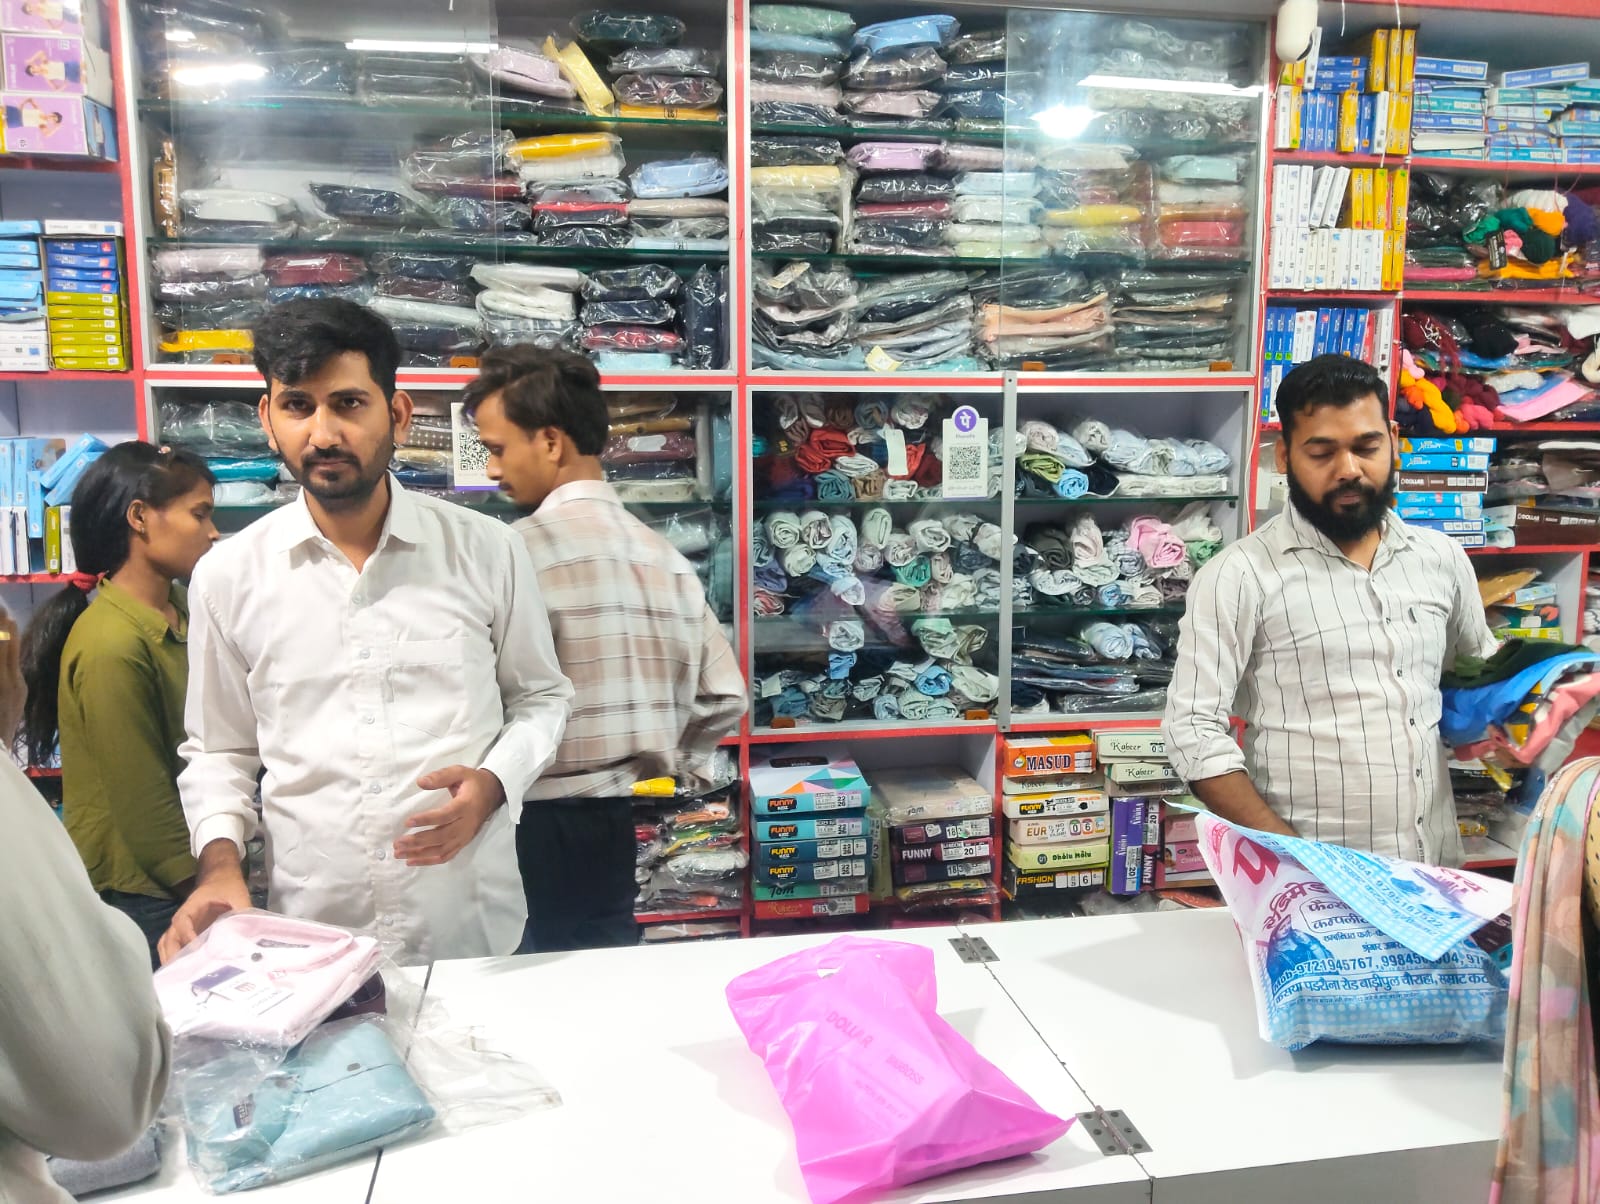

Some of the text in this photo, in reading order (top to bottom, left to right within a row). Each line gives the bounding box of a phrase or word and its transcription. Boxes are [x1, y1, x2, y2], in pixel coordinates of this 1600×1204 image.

[1110, 742, 1142, 753] Kabeer
[1026, 755, 1071, 771] MASUD
[902, 848, 932, 860] FUNNY
[1142, 854, 1154, 884] FUNNY
[1016, 875, 1054, 885] FASHION
[1342, 976, 1359, 990] रोड
[826, 1010, 873, 1048] DOLLAR
